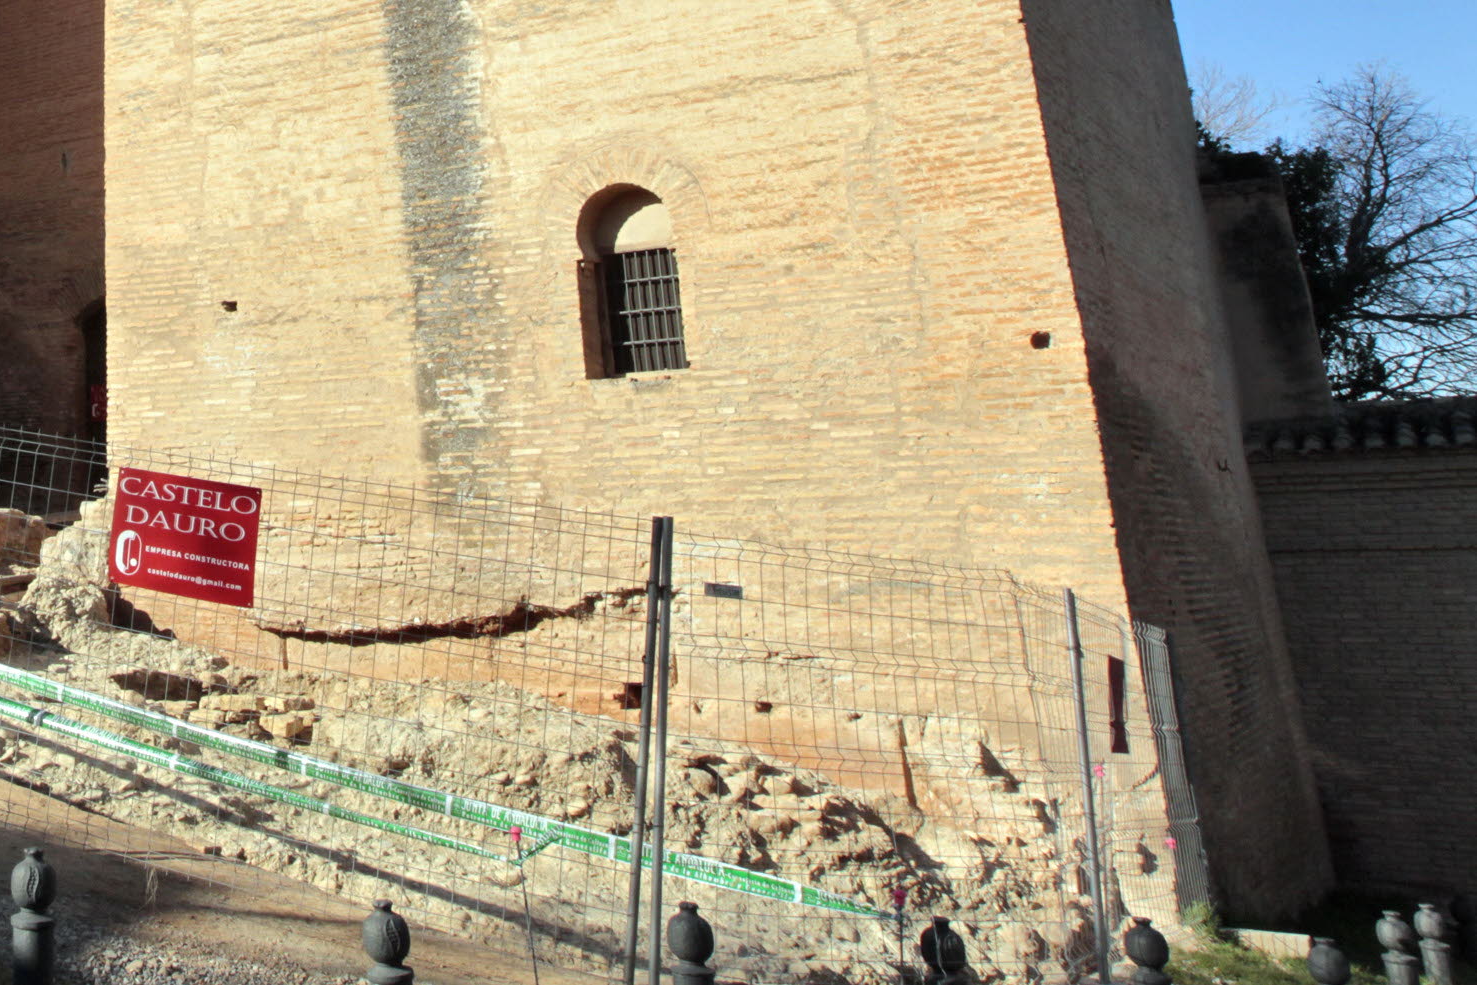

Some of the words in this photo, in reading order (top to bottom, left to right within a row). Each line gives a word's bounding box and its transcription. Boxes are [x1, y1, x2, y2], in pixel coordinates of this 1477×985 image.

[119, 476, 257, 515] CASTELO
[125, 504, 246, 542] DAURO
[145, 545, 182, 559] EMPRESA
[184, 552, 250, 571] CONSTRUCTORA
[147, 567, 242, 591] castelodauro@gmail.com
